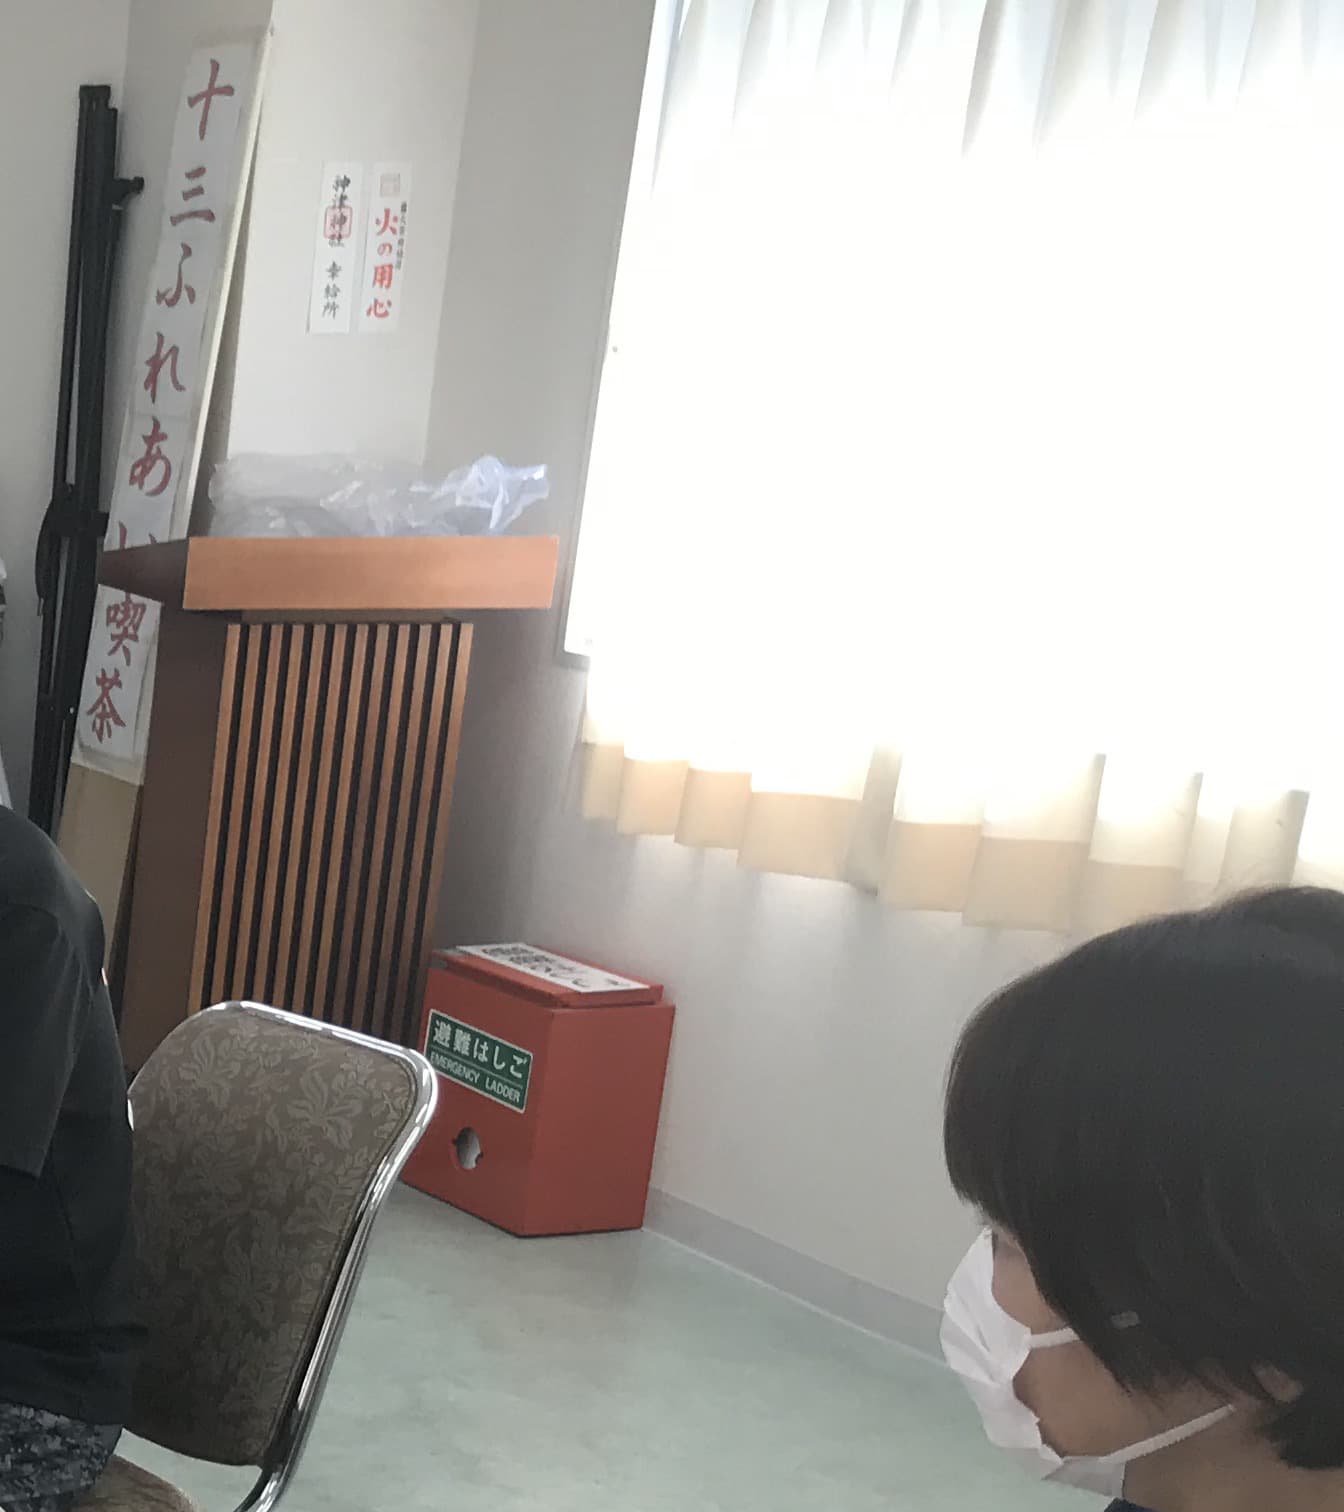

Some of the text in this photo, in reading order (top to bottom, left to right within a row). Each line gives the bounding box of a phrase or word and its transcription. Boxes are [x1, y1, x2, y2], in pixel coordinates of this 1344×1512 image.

[366, 208, 398, 318] 火の用心
[430, 1052, 522, 1104] EMERGENCY LADDER
[433, 1018, 528, 1079] 避難はしご
